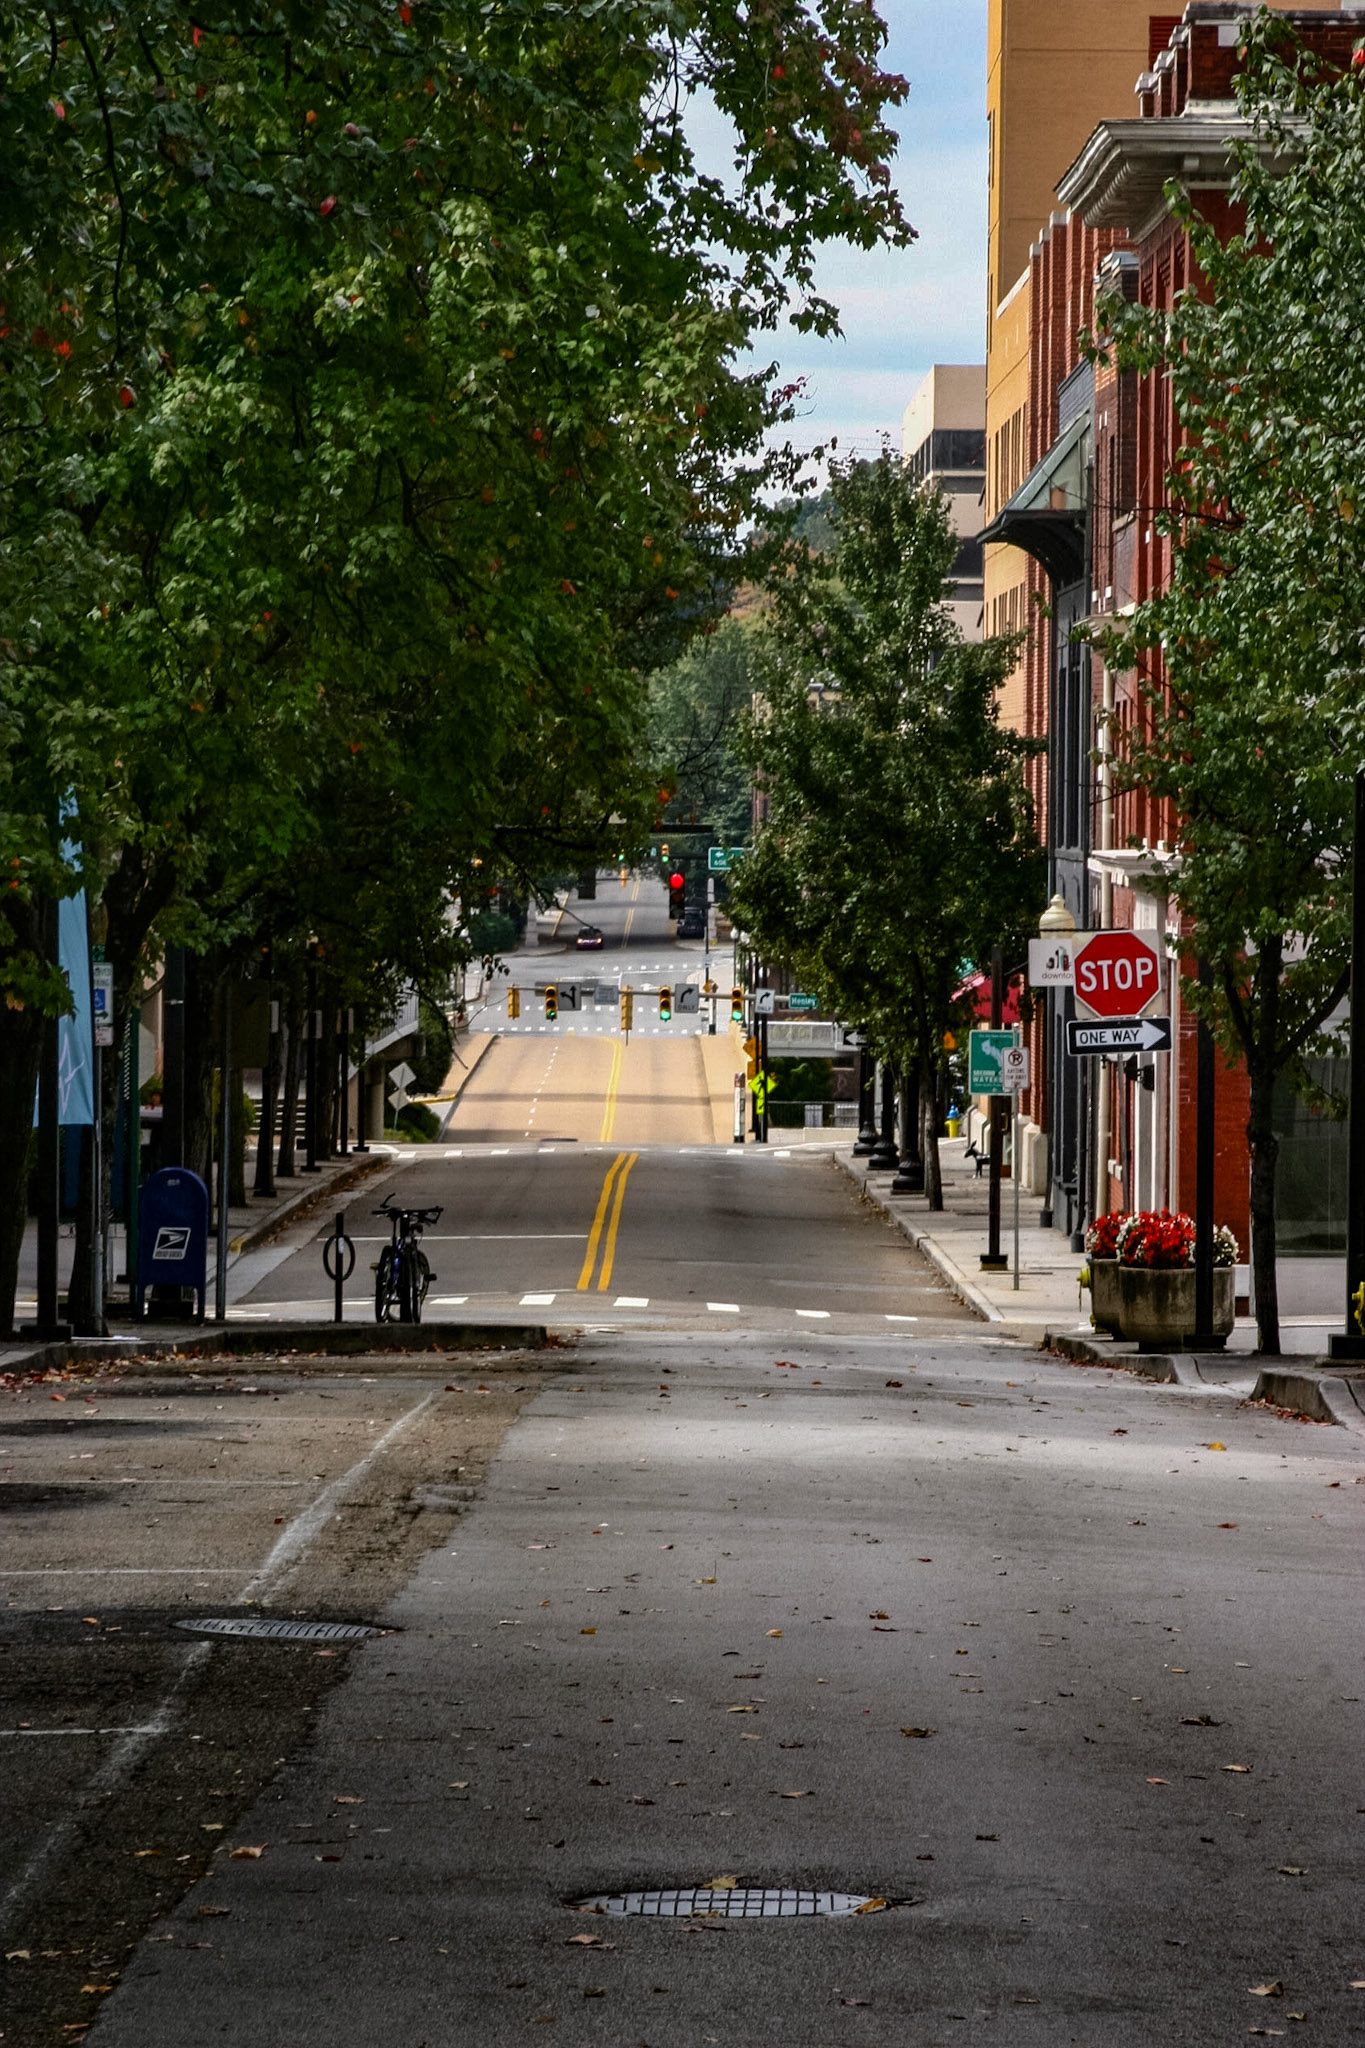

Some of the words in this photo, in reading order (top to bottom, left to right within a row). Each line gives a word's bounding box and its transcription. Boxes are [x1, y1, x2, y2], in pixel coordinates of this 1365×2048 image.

[1080, 957, 1154, 992] STOP
[1079, 1031, 1108, 1045] ONE
[1112, 1029, 1140, 1043] WAY
